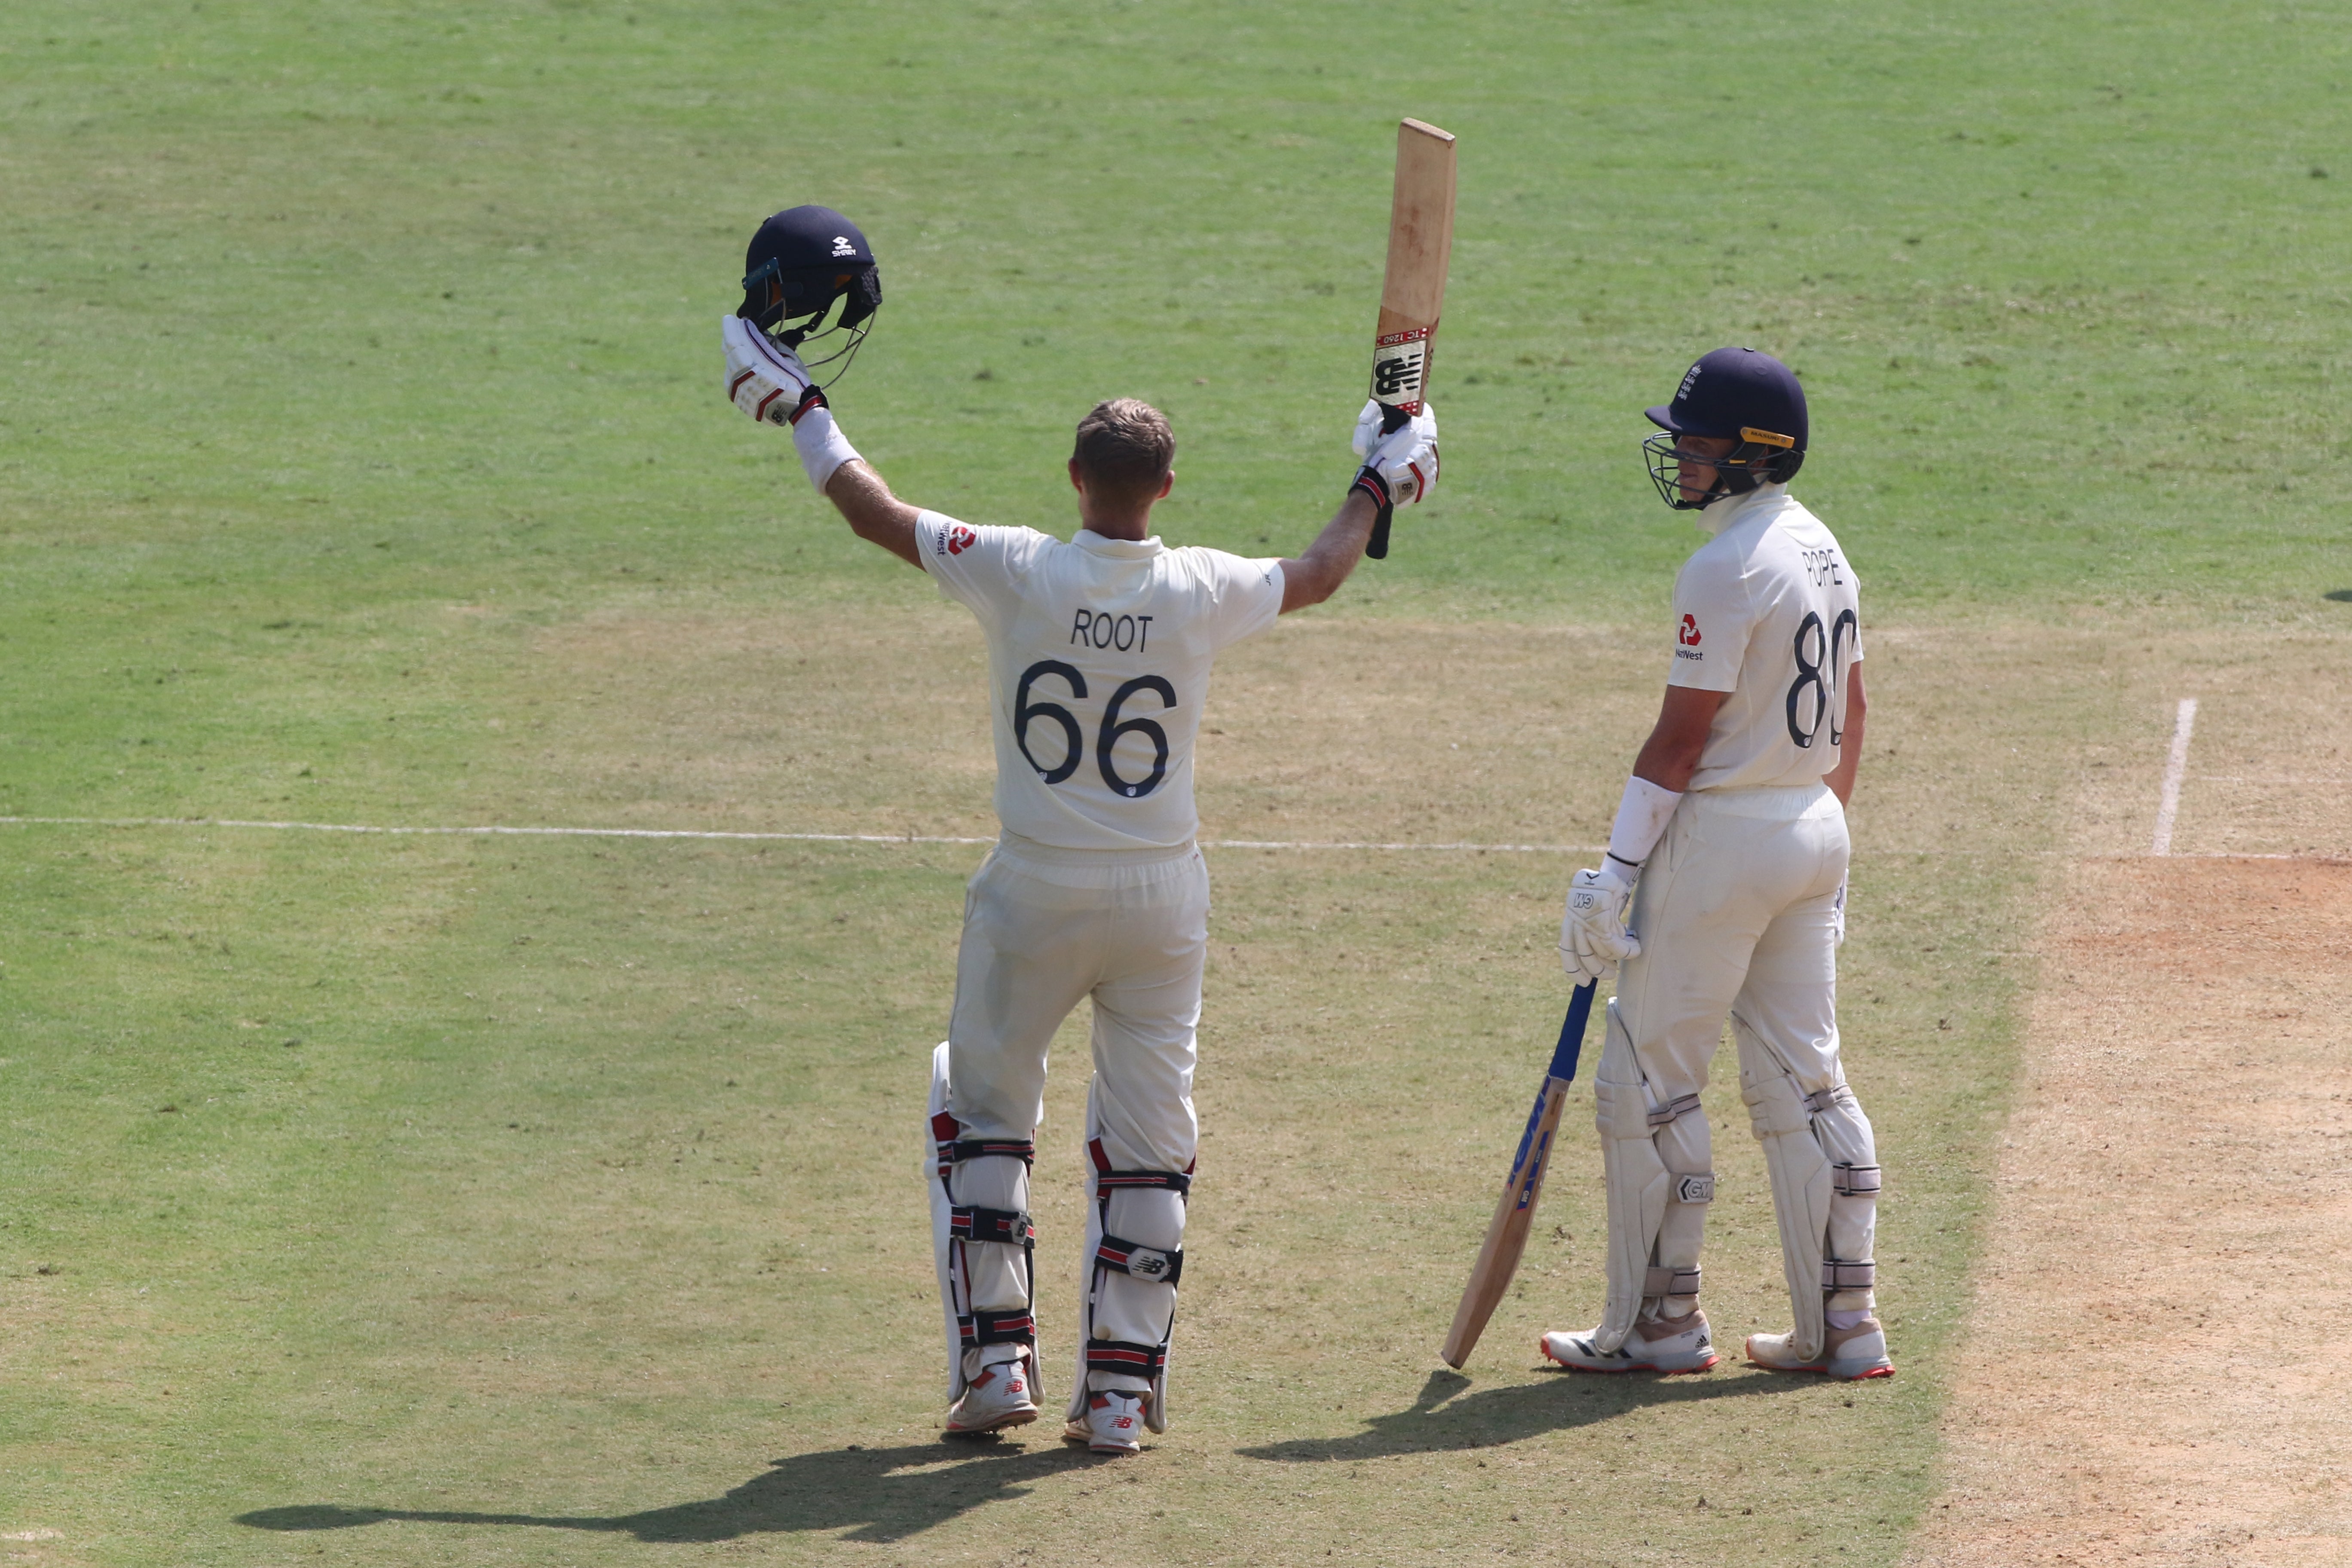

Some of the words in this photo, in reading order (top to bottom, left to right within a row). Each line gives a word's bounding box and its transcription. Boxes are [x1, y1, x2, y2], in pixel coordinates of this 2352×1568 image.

[1384, 334, 1403, 343] 1260
[1407, 331, 1419, 339] TC
[1751, 431, 1779, 441] MASURI
[1801, 548, 1843, 587] POPE
[1070, 609, 1153, 653] ROOT
[1785, 608, 1857, 748] 80
[1014, 659, 1177, 798] 66
[1574, 893, 1594, 909] GM
